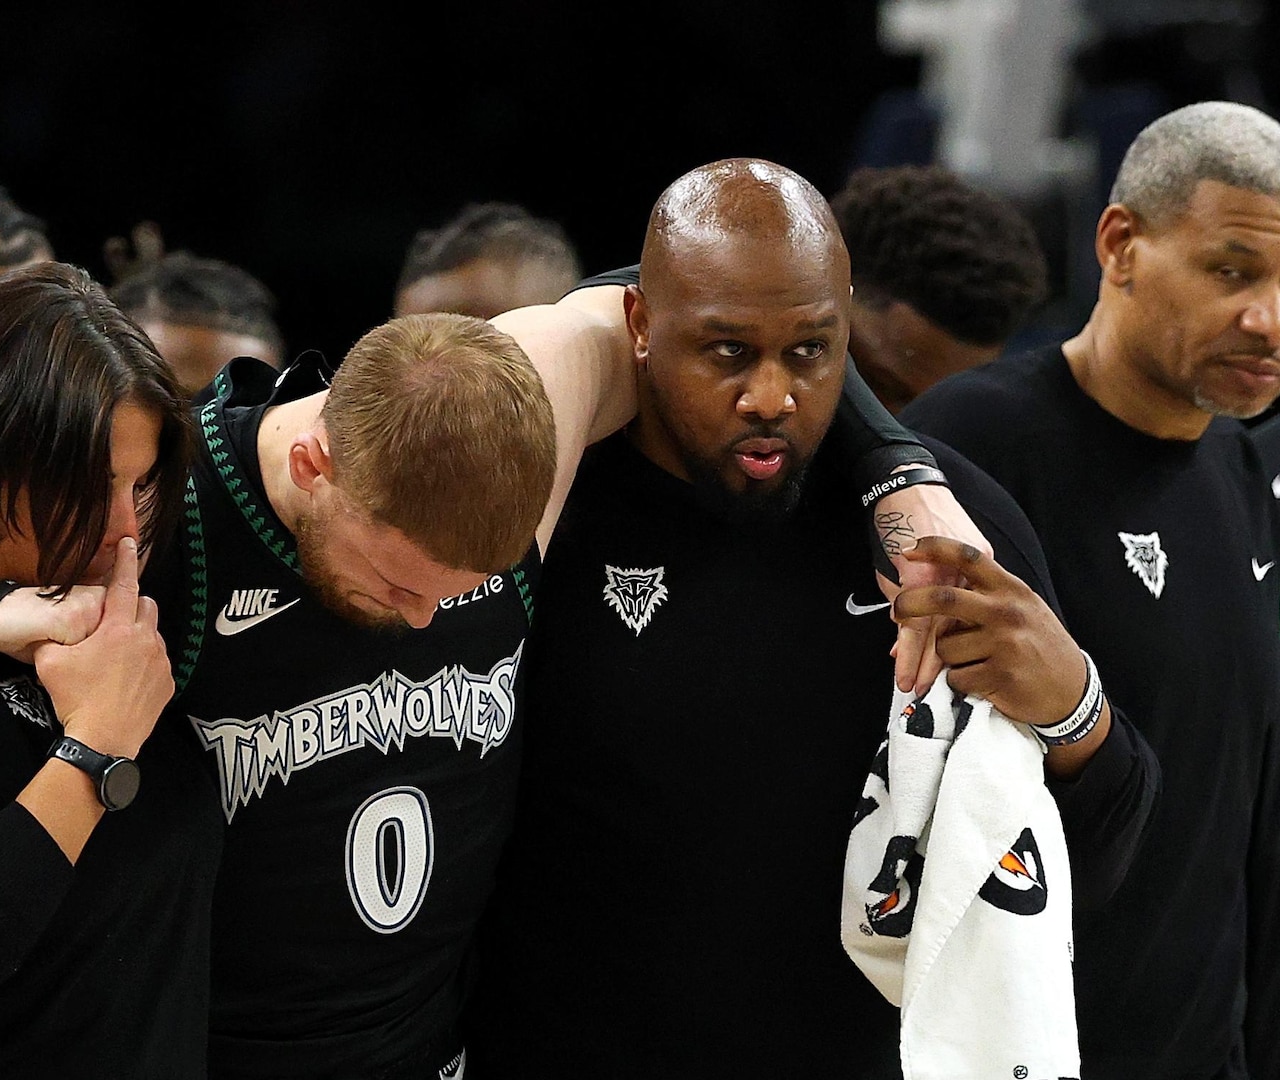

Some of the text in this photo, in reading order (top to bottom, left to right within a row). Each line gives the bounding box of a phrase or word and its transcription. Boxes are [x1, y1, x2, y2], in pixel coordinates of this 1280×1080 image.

[861, 475, 908, 507] Believe
[227, 588, 280, 617] NIKE
[439, 574, 504, 611] ezzle
[187, 637, 526, 826] TIMBERWOLVES
[344, 785, 435, 935] 0
